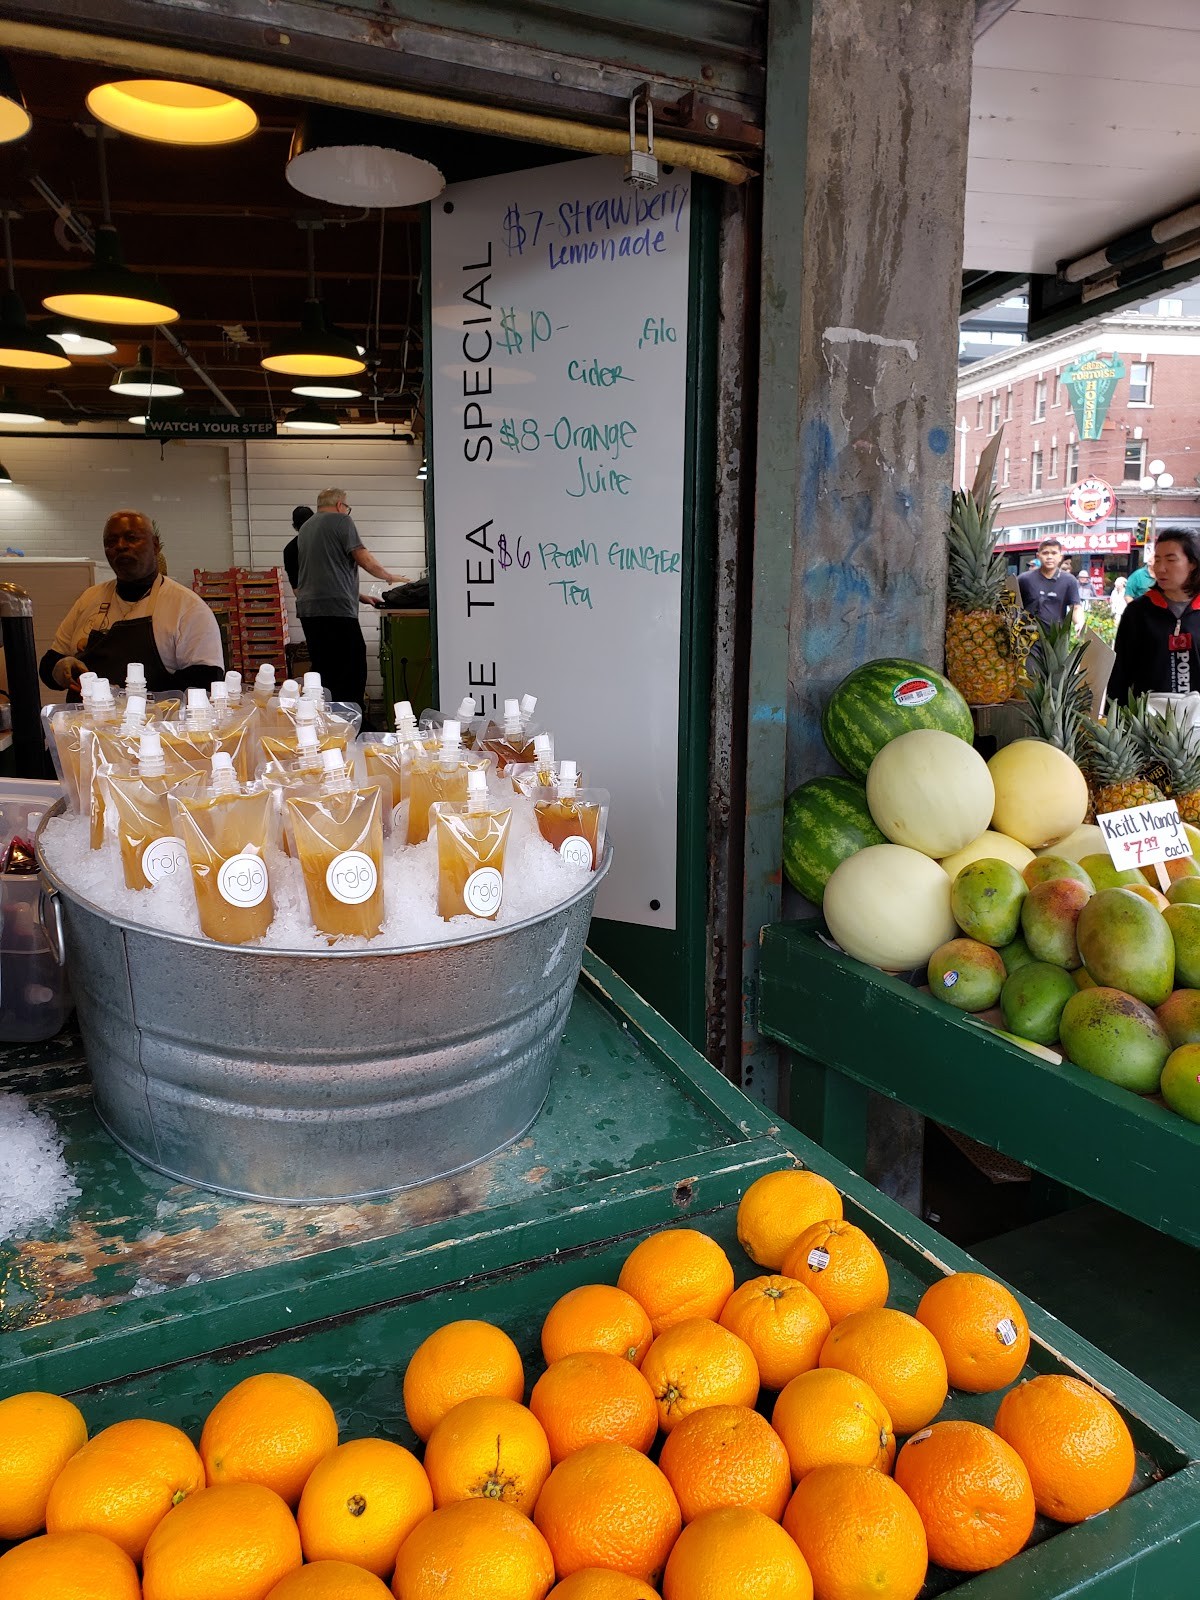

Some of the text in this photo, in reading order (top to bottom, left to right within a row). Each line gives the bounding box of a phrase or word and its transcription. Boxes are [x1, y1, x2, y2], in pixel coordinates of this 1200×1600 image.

[463, 241, 493, 462] SPECIAL
[1083, 380, 1097, 439] HOSTEL
[150, 421, 273, 433] WATCH YOUR STEP
[465, 518, 495, 617] TEA
[497, 534, 531, 572] $6
[1009, 617, 1026, 645] WEET
[1148, 766, 1166, 781] WEET
[1102, 810, 1181, 839] Keitt Mango
[1164, 838, 1190, 858] each
